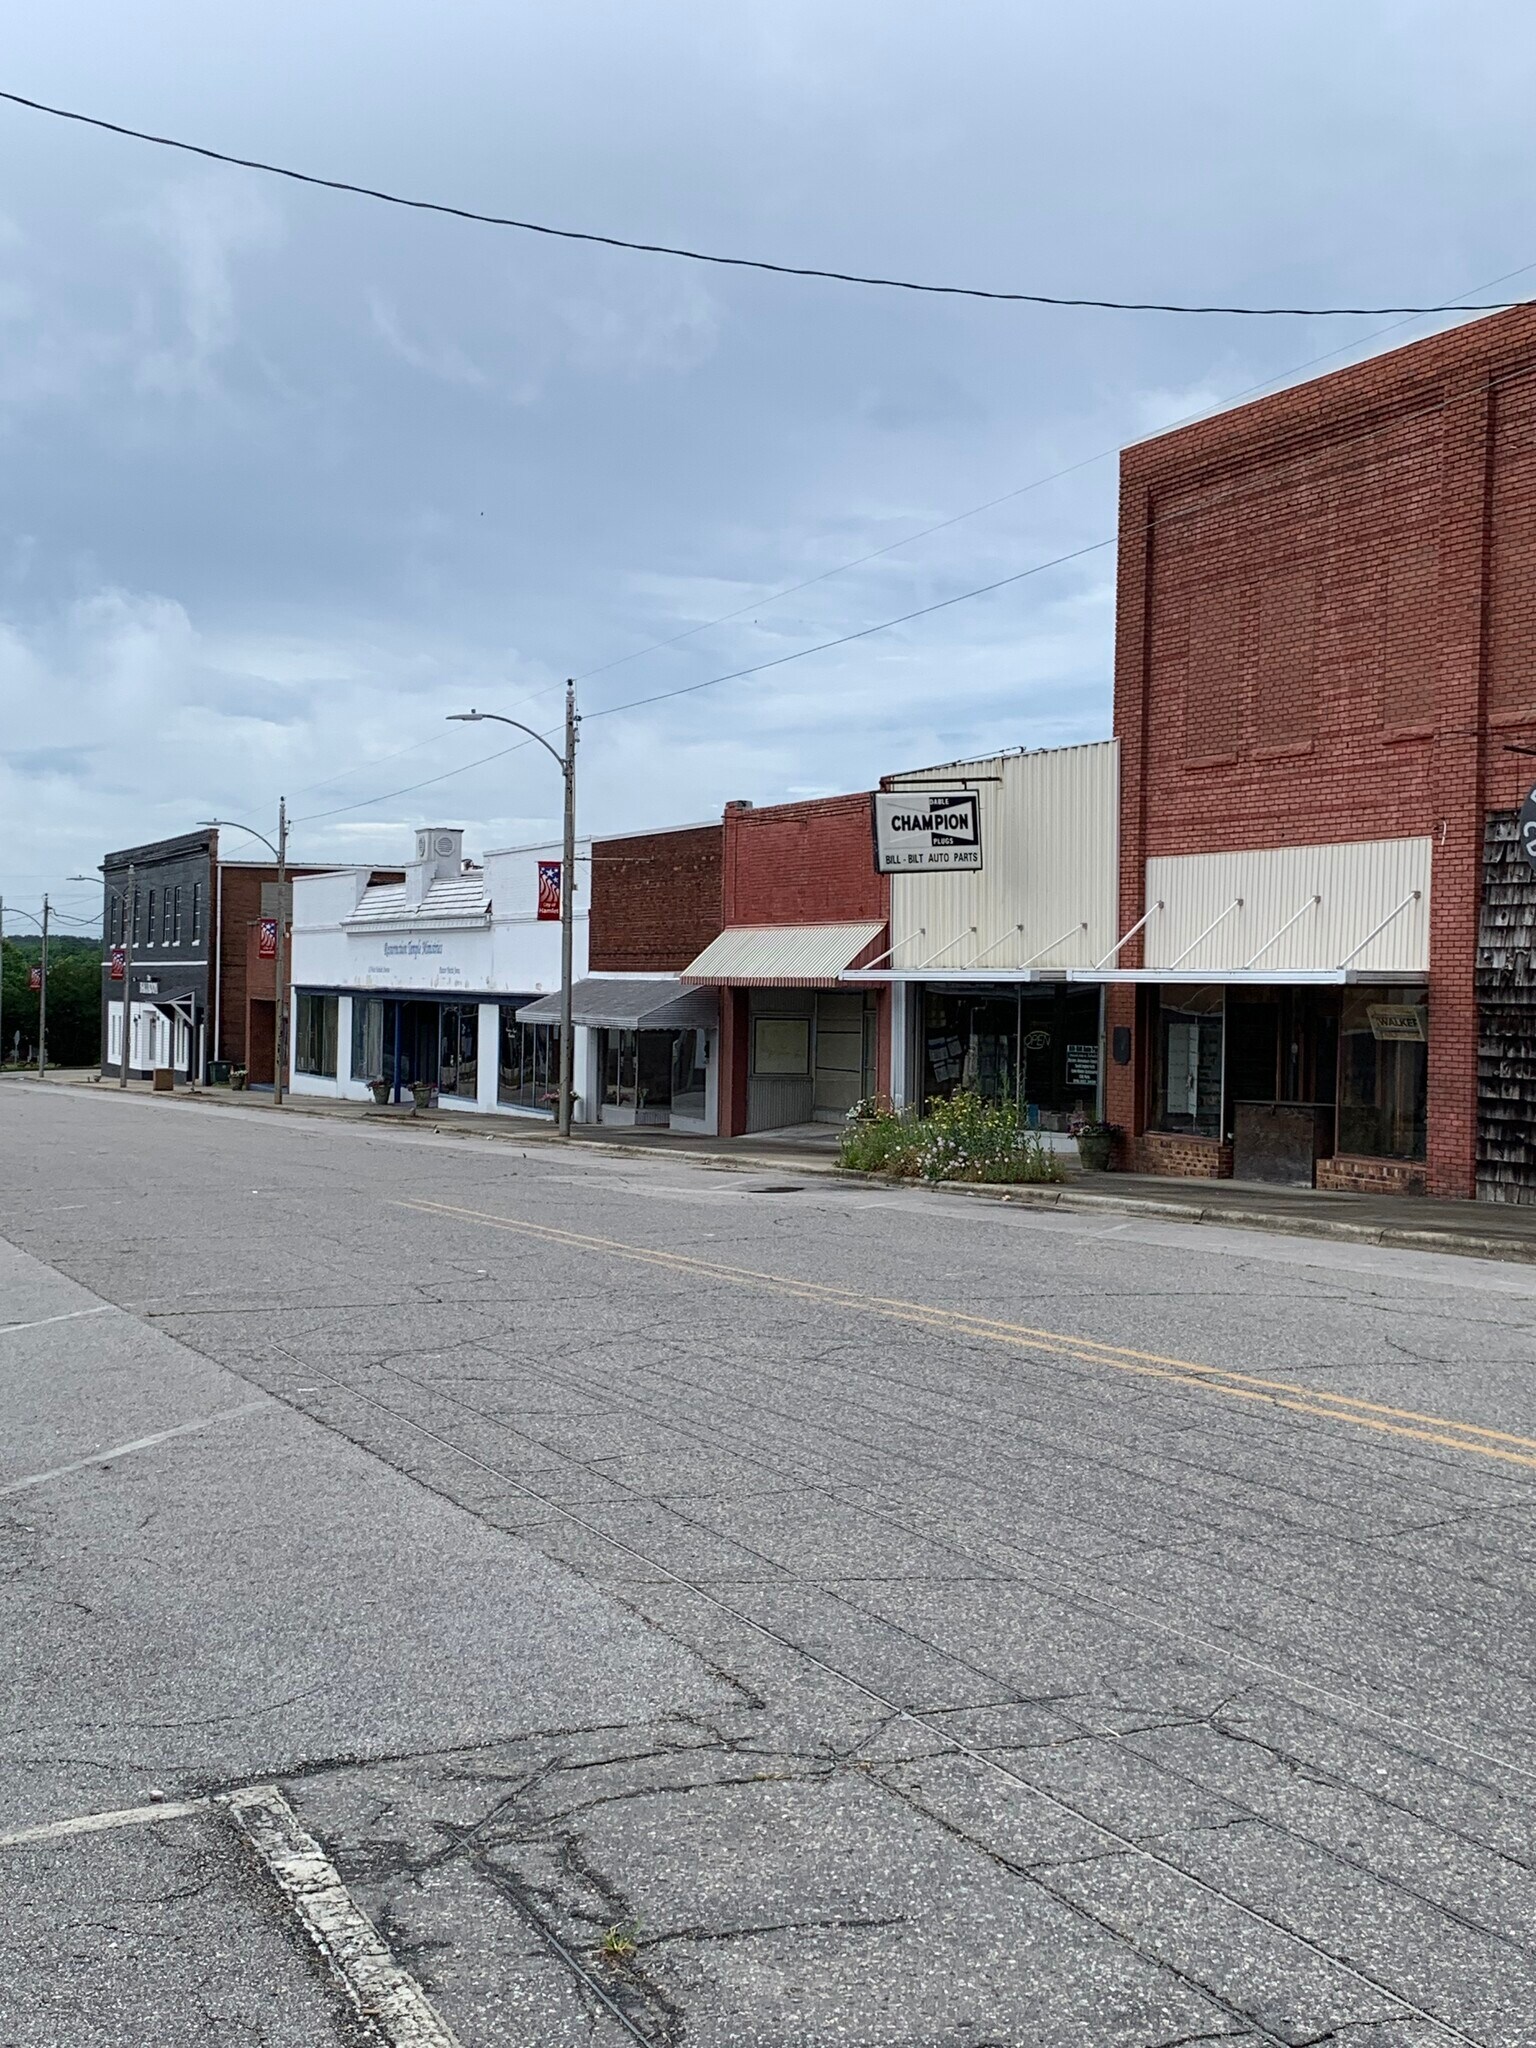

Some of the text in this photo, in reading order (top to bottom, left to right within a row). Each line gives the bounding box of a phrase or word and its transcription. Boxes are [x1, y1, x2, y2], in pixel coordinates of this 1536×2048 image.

[891, 813, 969, 831] CHAMPION
[933, 837, 954, 845] PLUGS
[928, 853, 949, 863] AUTO
[953, 852, 978, 862] PARTS
[1024, 1031, 1050, 1049] OPEN
